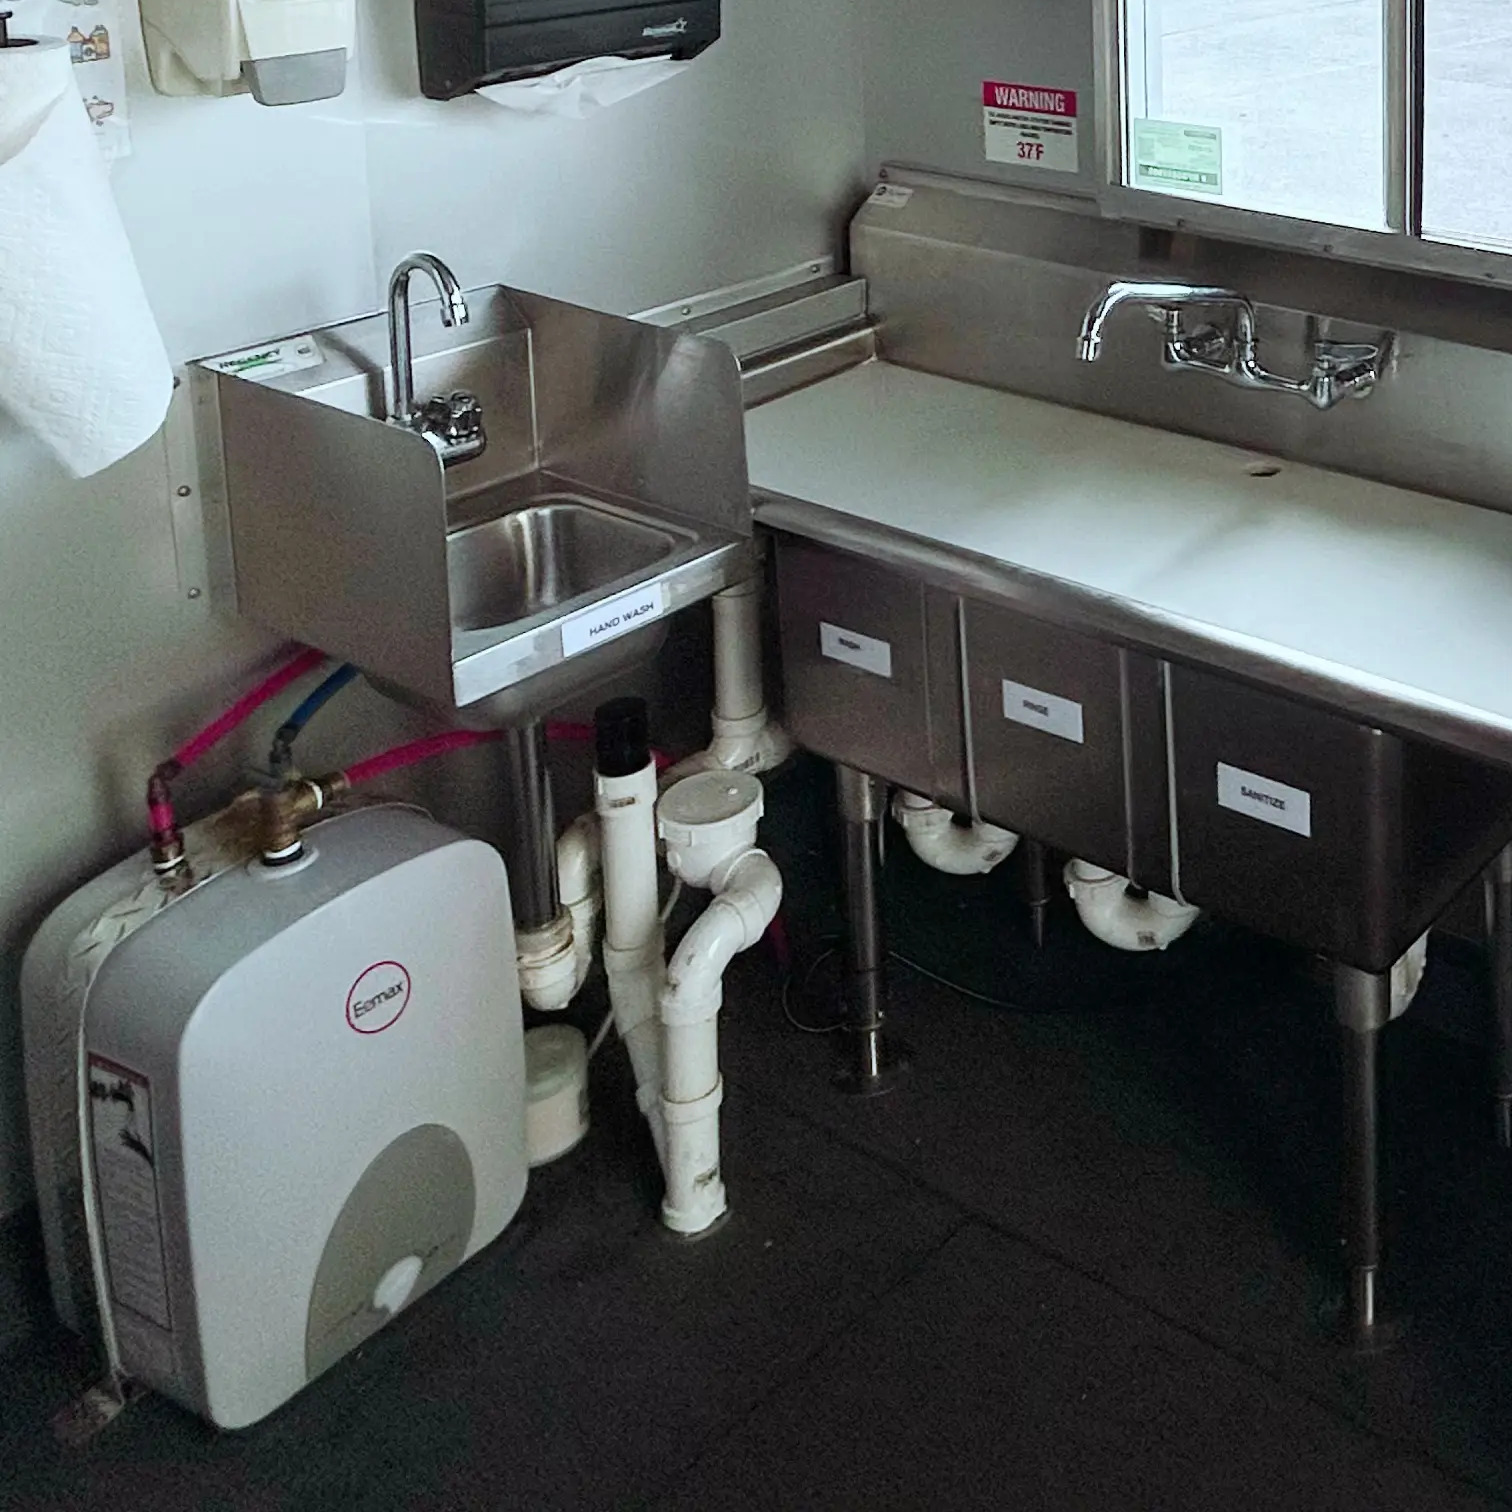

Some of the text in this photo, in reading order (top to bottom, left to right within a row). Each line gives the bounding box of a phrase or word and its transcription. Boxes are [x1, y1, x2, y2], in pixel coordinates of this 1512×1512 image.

[994, 86, 1066, 113] WARNING
[589, 602, 655, 637] HAND WASH
